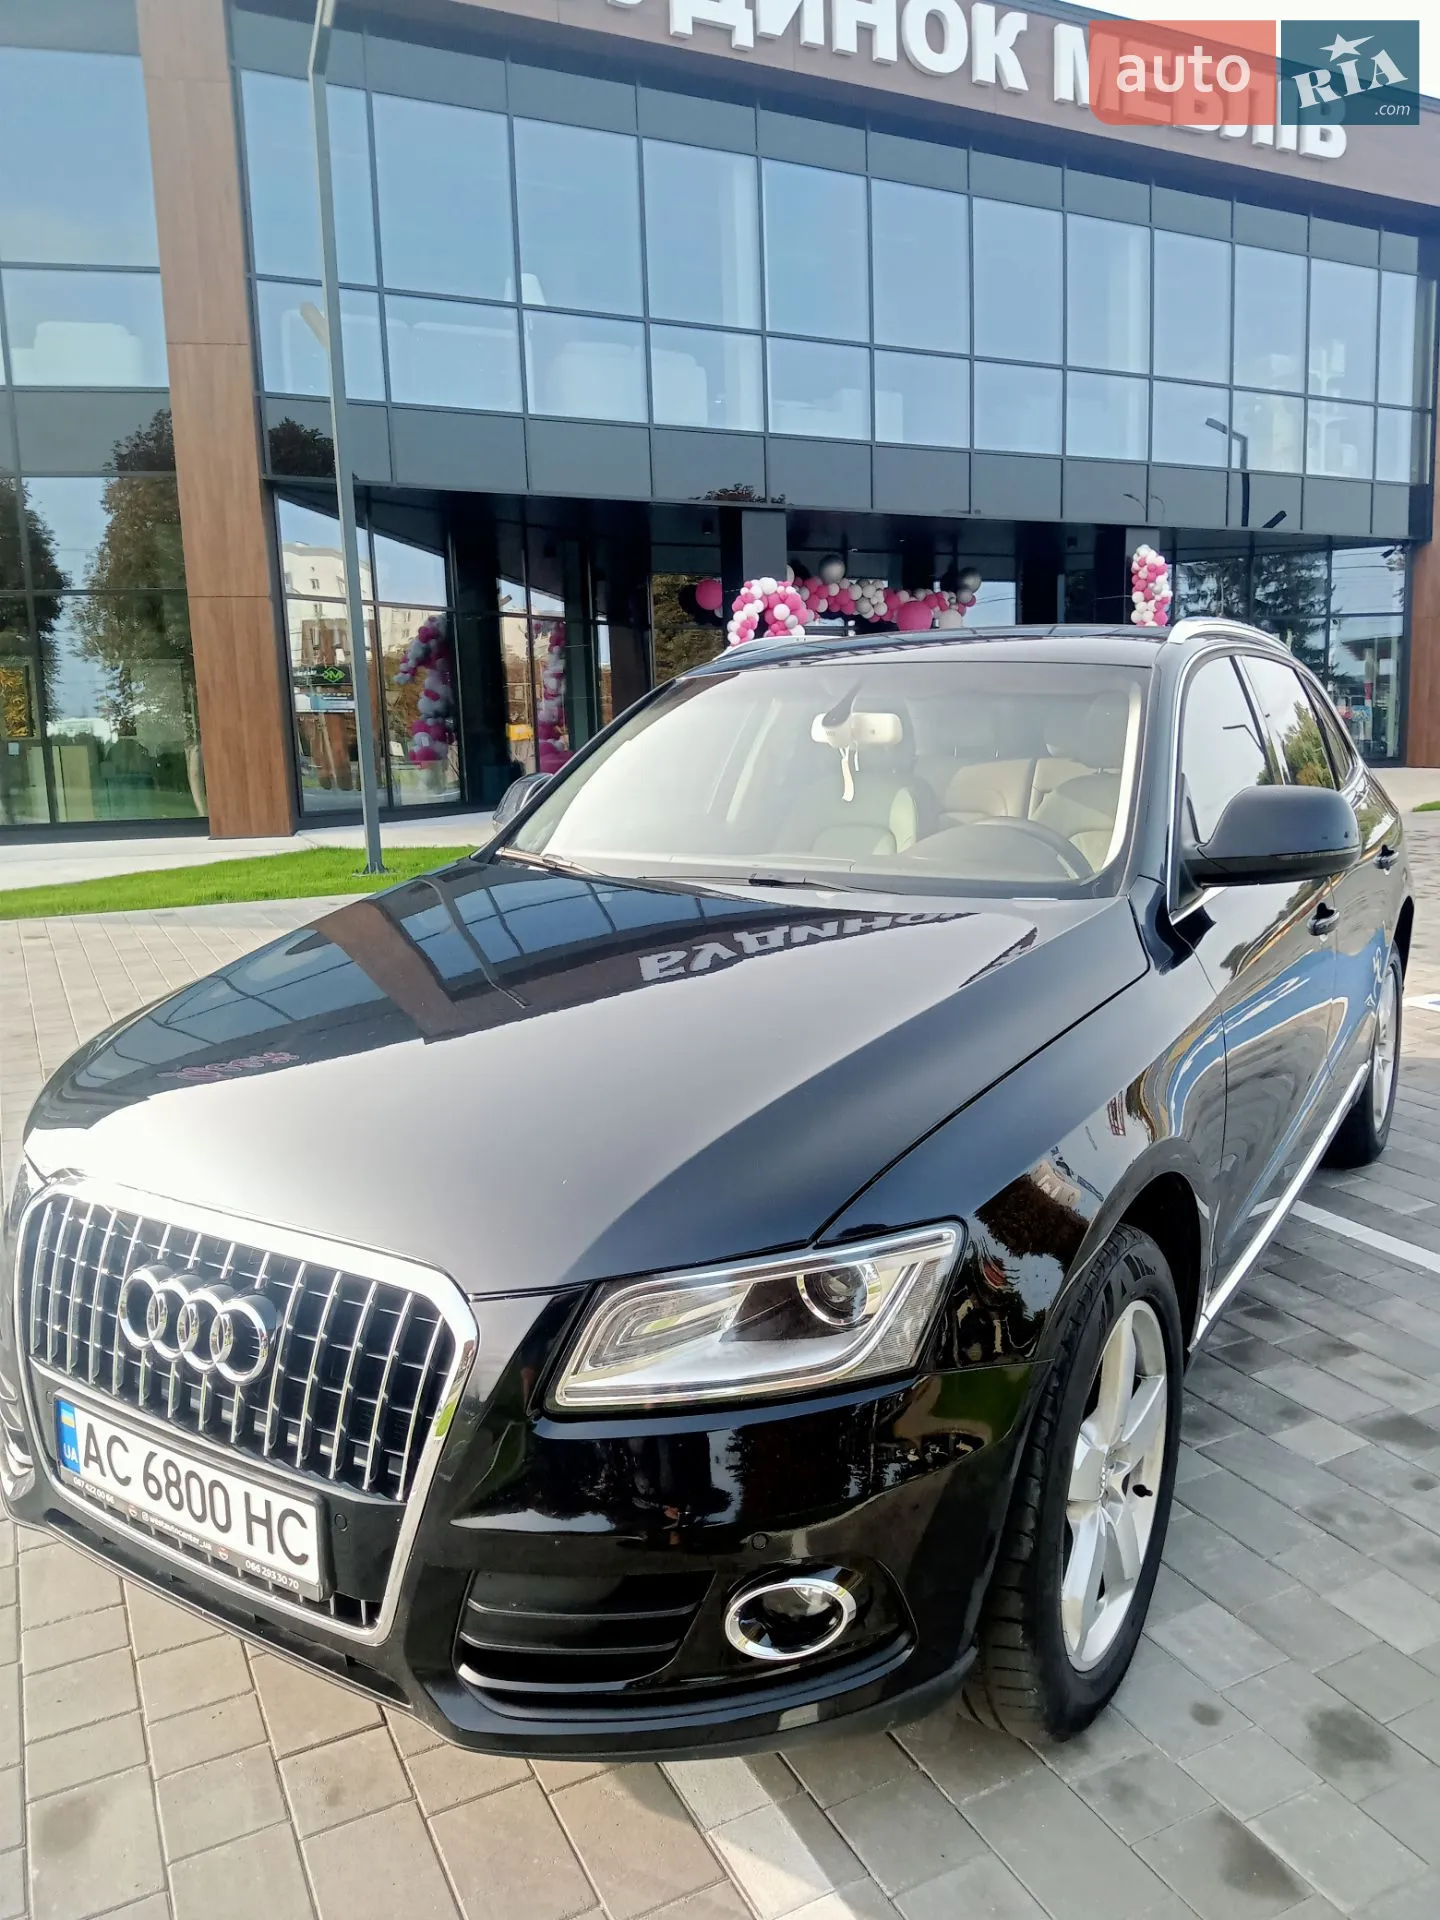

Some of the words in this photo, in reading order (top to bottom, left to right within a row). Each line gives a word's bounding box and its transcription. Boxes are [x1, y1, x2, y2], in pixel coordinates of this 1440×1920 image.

[604, 0, 1029, 93] ИНОК
[63, 1442, 79, 1464] UA
[84, 1422, 132, 1486] AC
[143, 1451, 232, 1534] 6800
[244, 1491, 309, 1566] HC
